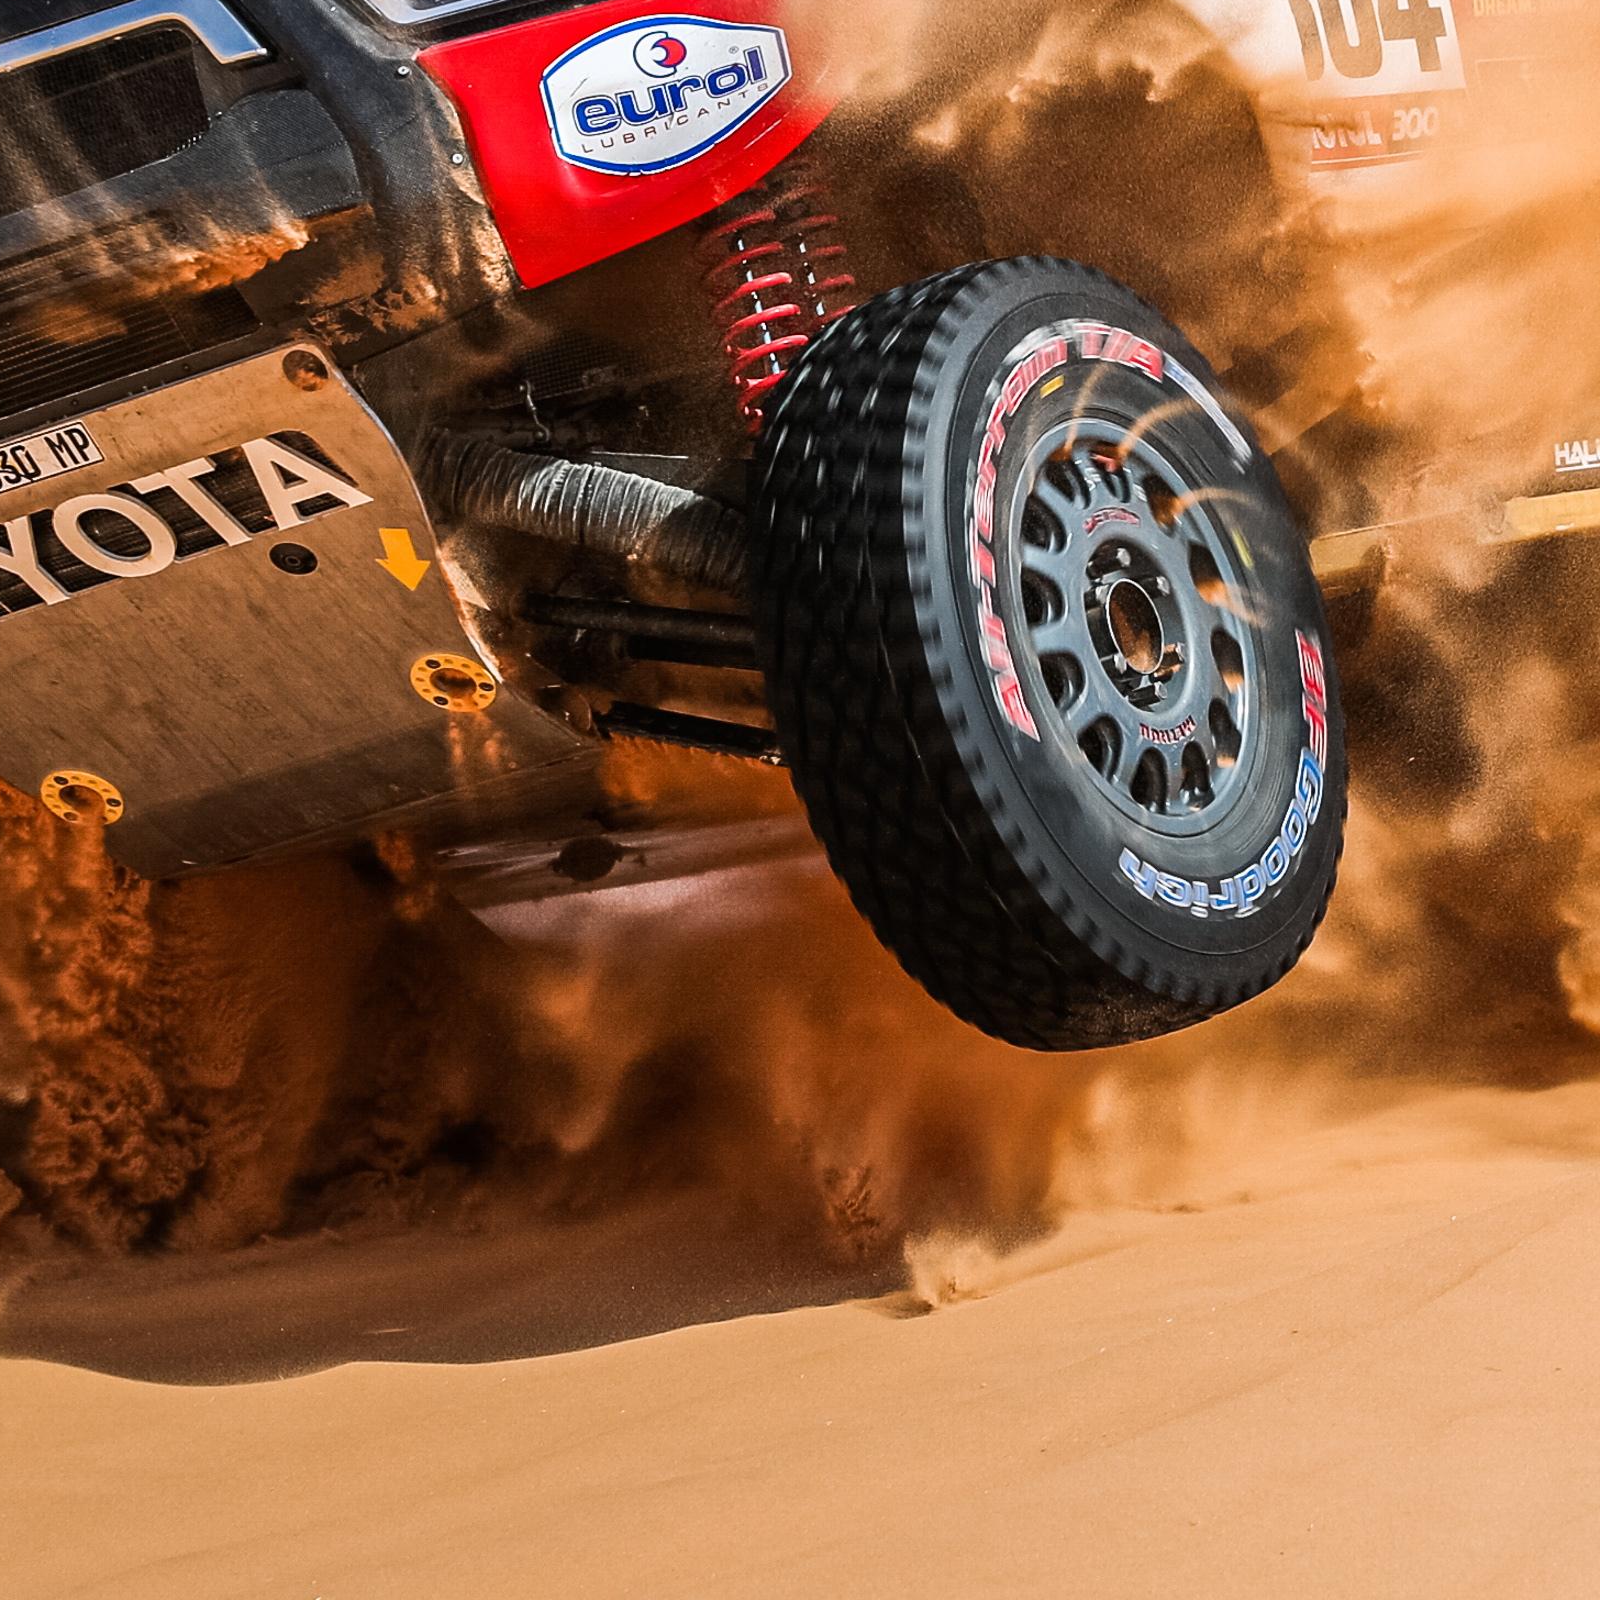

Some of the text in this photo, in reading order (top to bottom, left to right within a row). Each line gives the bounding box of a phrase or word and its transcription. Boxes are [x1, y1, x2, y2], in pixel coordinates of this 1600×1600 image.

[572, 45, 767, 136] eurol
[582, 84, 768, 153] LUBRICANTS
[1392, 106, 1439, 141] 300
[44, 428, 90, 469] MP
[1119, 628, 1328, 918] BFGoodrich
